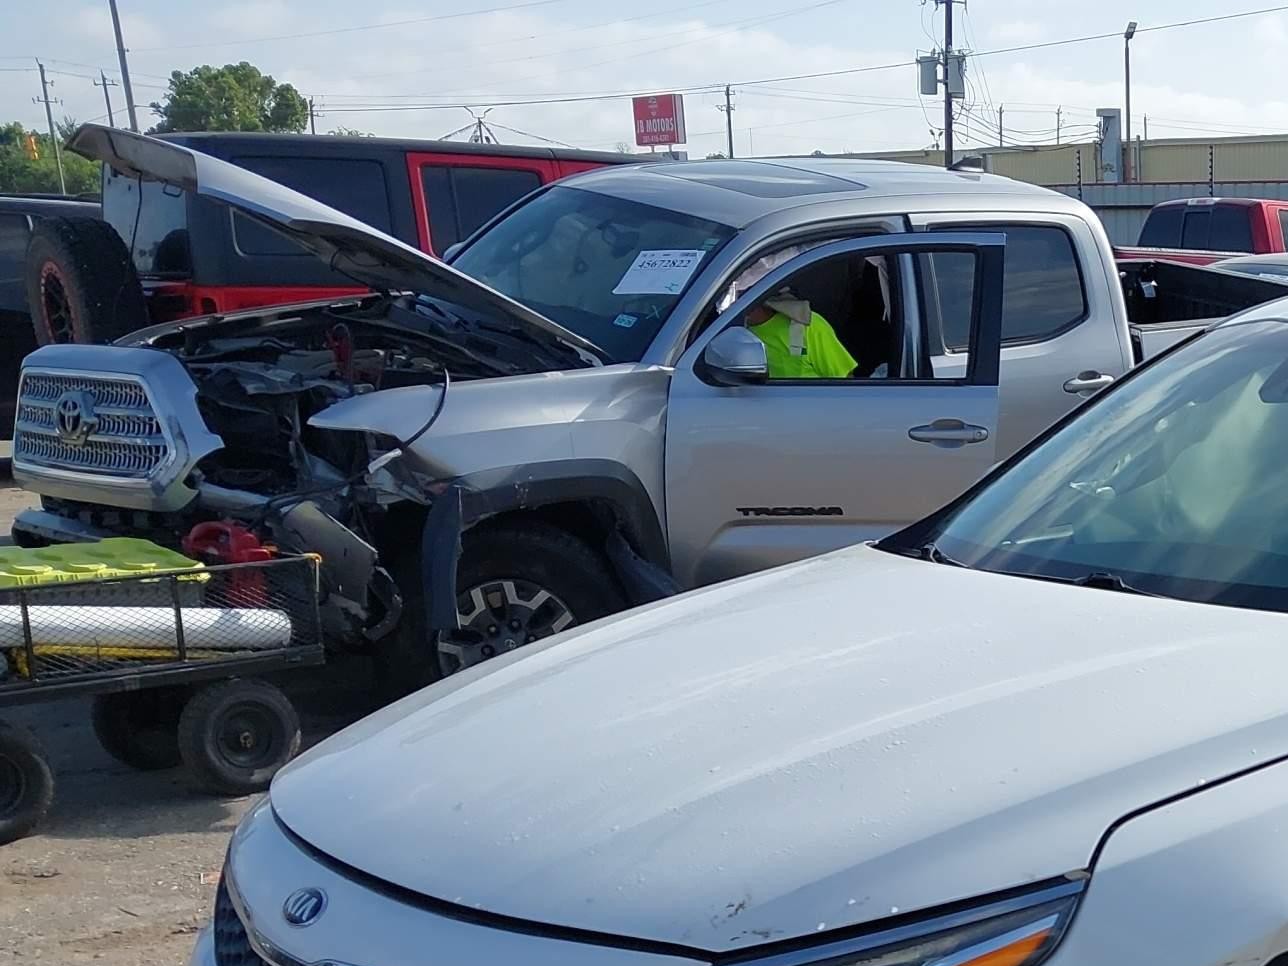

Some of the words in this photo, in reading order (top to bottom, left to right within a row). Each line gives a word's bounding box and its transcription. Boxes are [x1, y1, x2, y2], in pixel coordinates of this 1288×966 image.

[646, 117, 674, 133] MOTORS
[638, 259, 691, 269] 45672822
[736, 507, 844, 516] TACOMA
